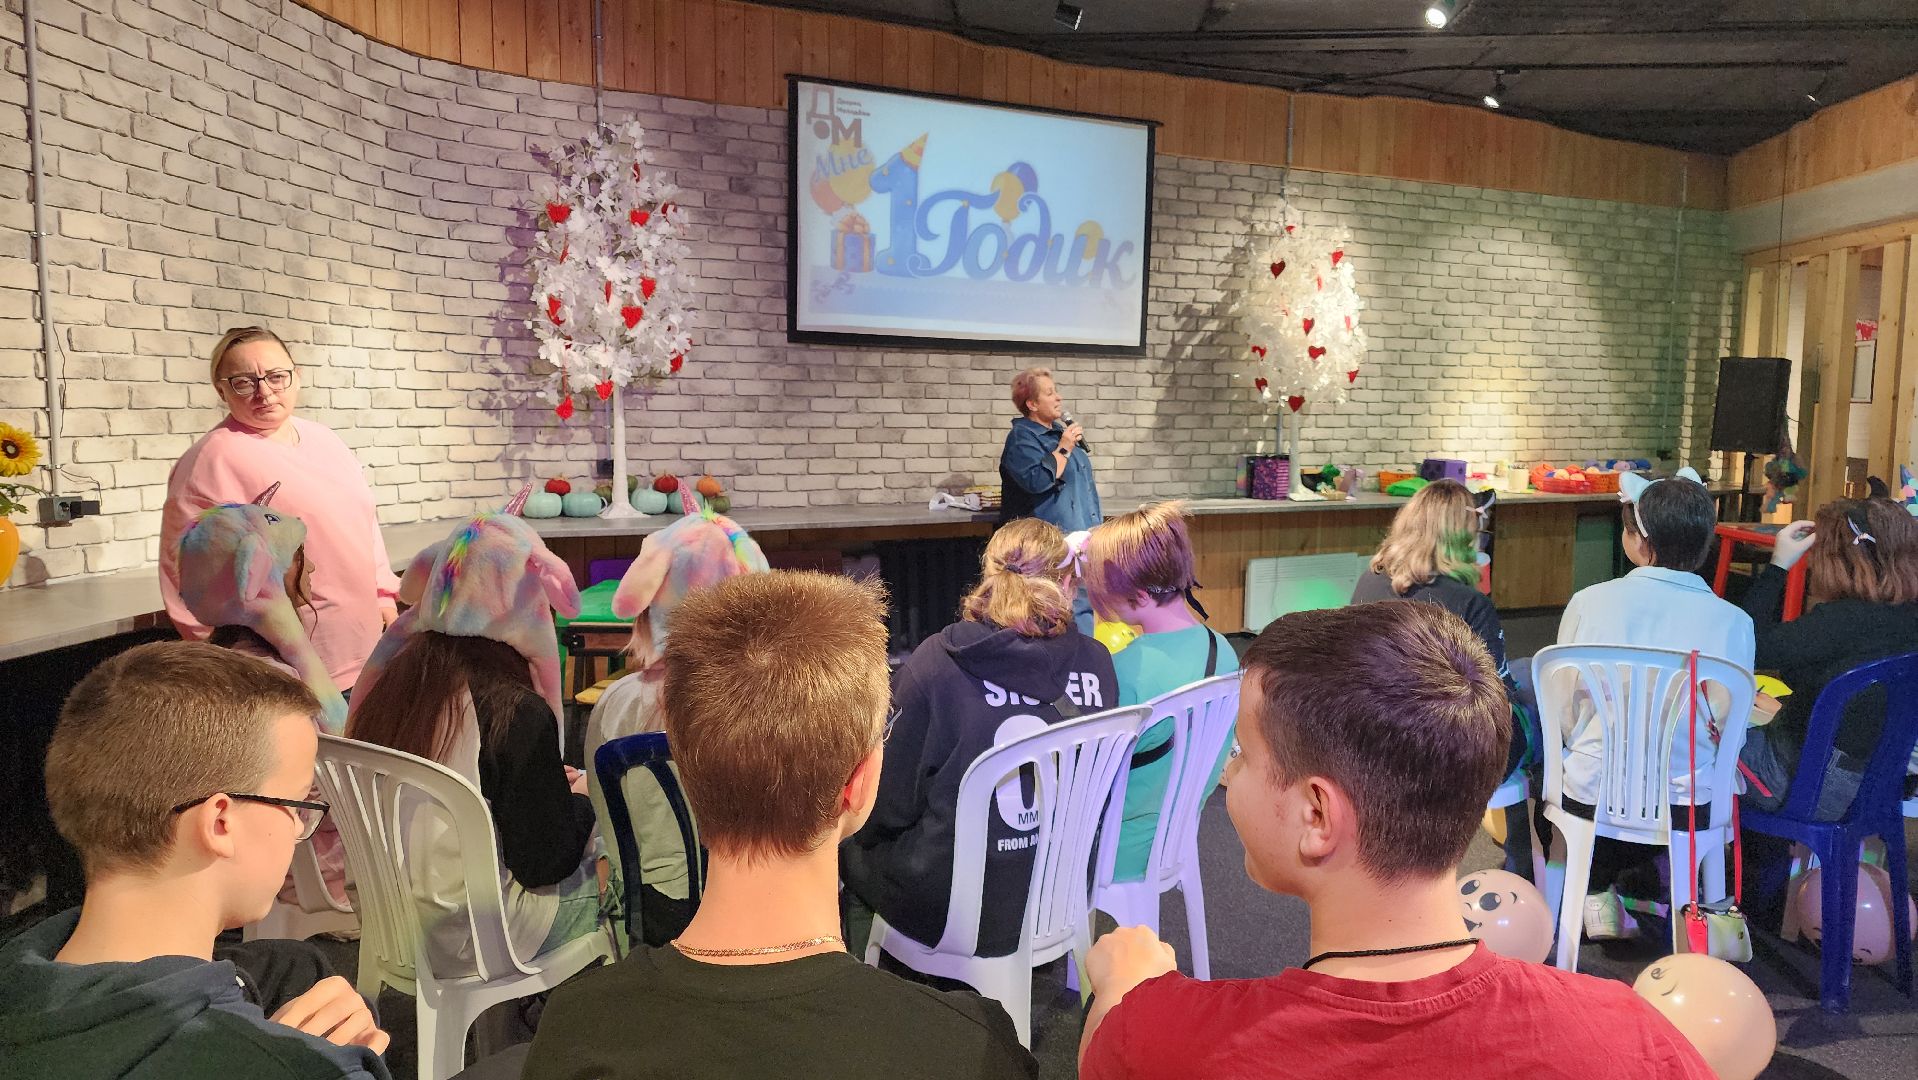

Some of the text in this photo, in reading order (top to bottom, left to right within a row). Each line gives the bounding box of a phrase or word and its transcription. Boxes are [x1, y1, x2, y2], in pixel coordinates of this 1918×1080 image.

[815, 149, 872, 182] Мне
[868, 150, 1136, 290] 1 Годик
[983, 672, 1103, 707] SER
[997, 837, 1029, 851] FROM
